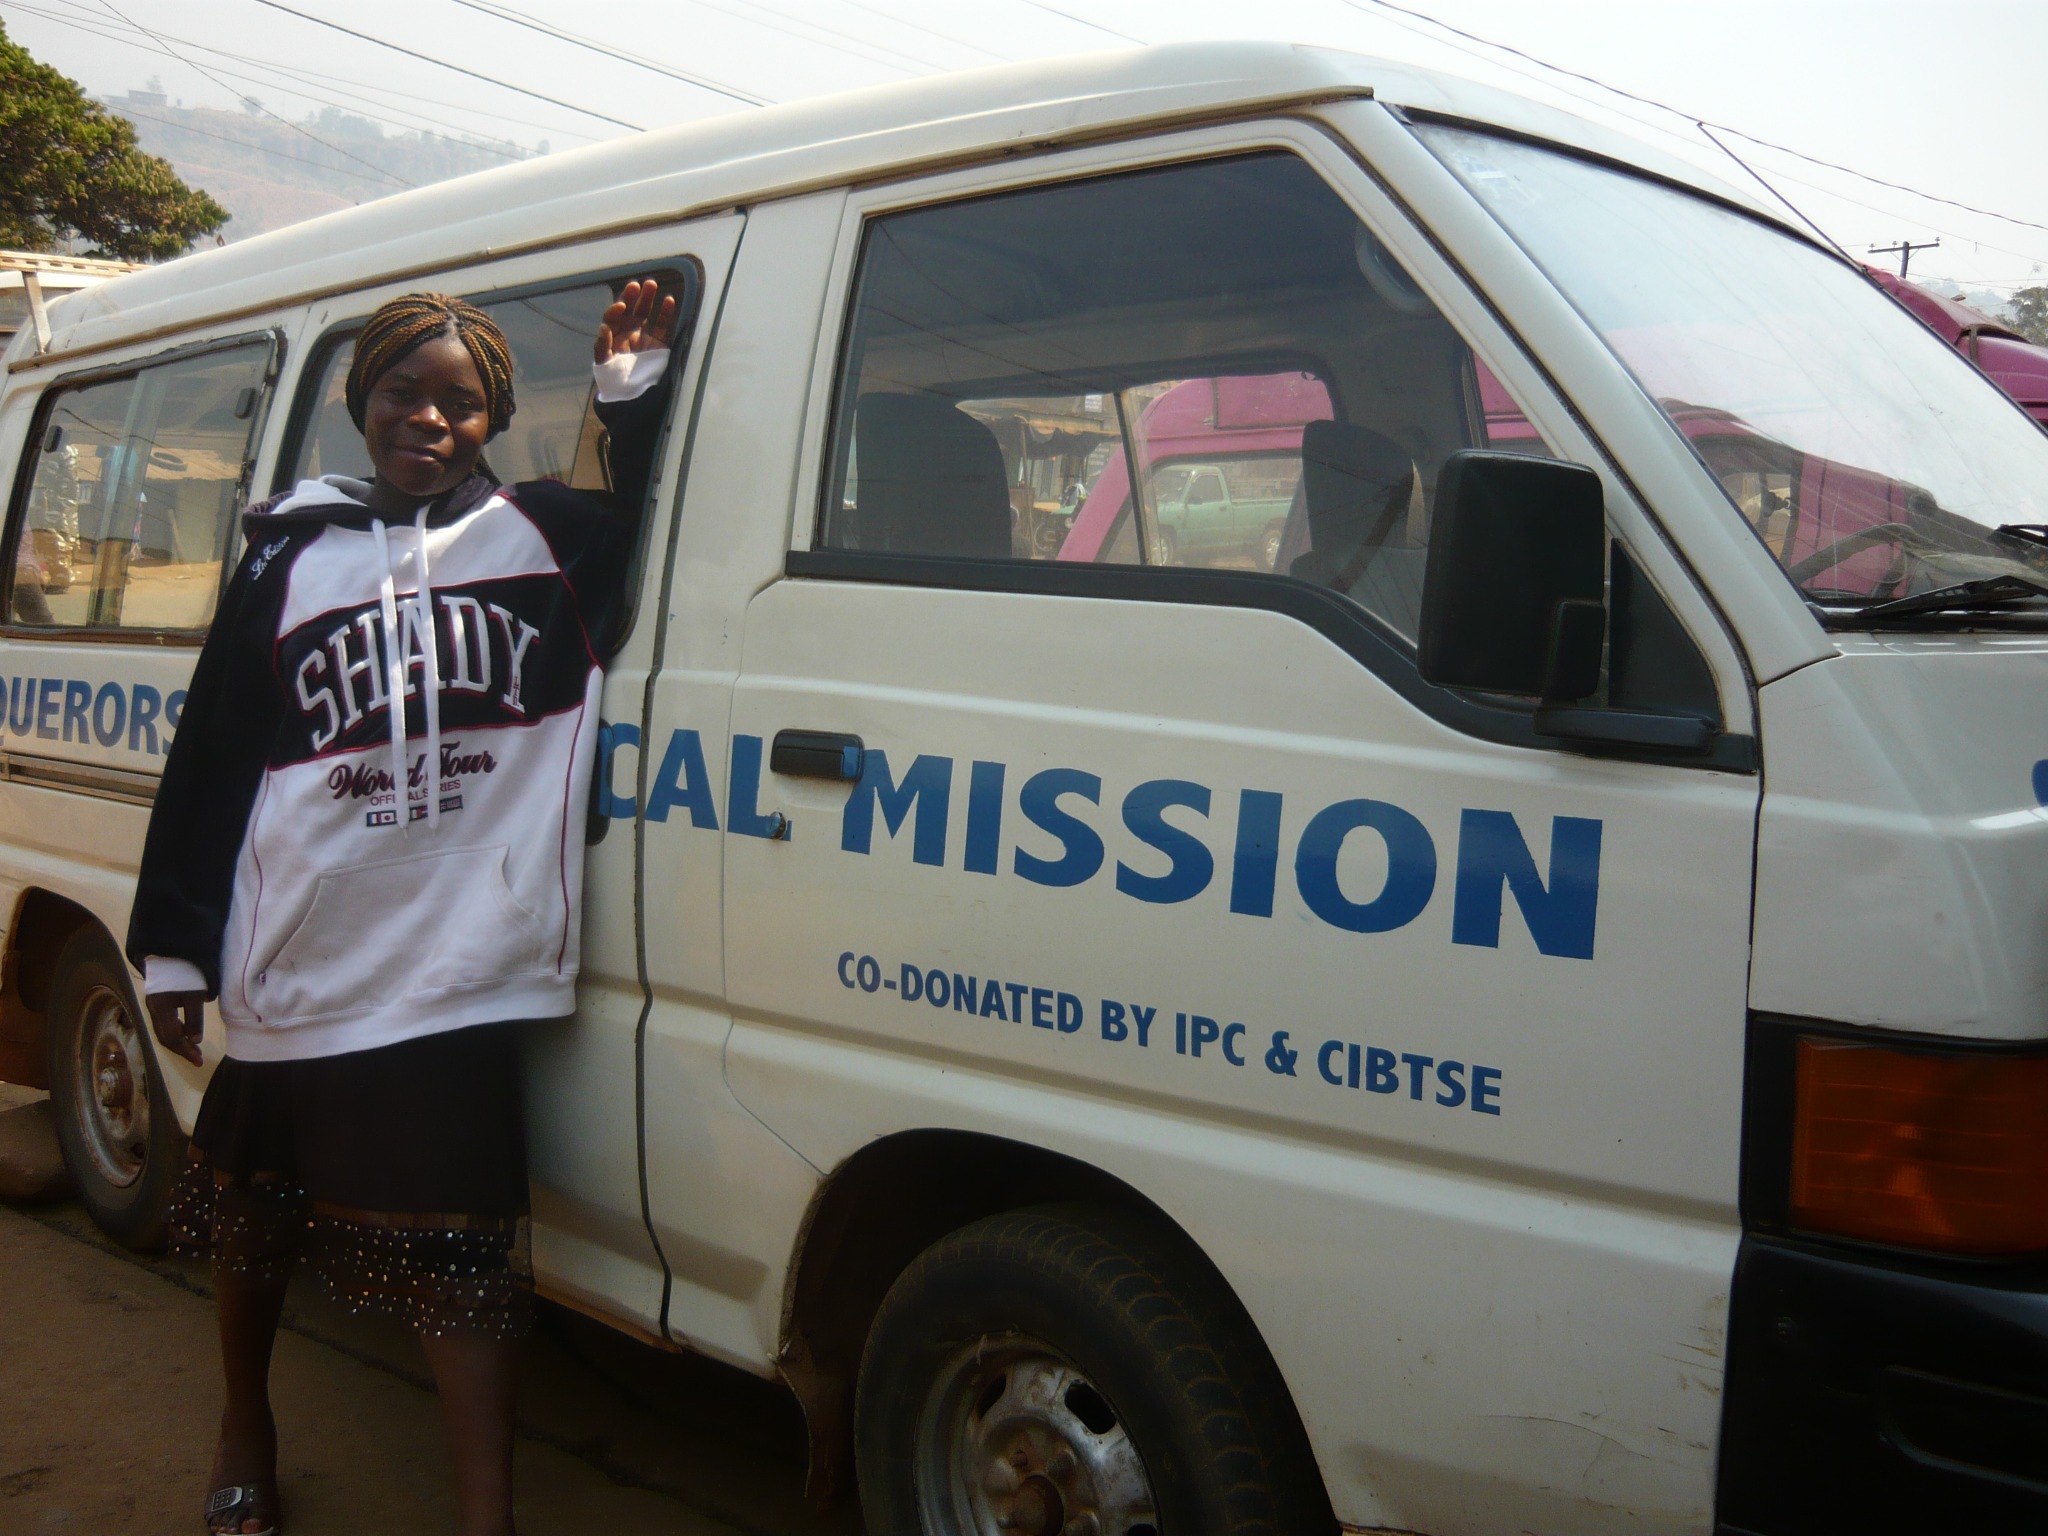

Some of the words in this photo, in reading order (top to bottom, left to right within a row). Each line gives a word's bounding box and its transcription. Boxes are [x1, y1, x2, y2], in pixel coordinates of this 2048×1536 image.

[296, 595, 540, 752] SHADY
[841, 748, 1603, 960] MISSION
[837, 951, 1084, 1034] CO-DONATED
[1101, 999, 1158, 1048] BY
[1175, 1012, 1246, 1067] IPC
[1265, 1030, 1298, 1077] &
[1317, 1039, 1502, 1116] CIBTSE
